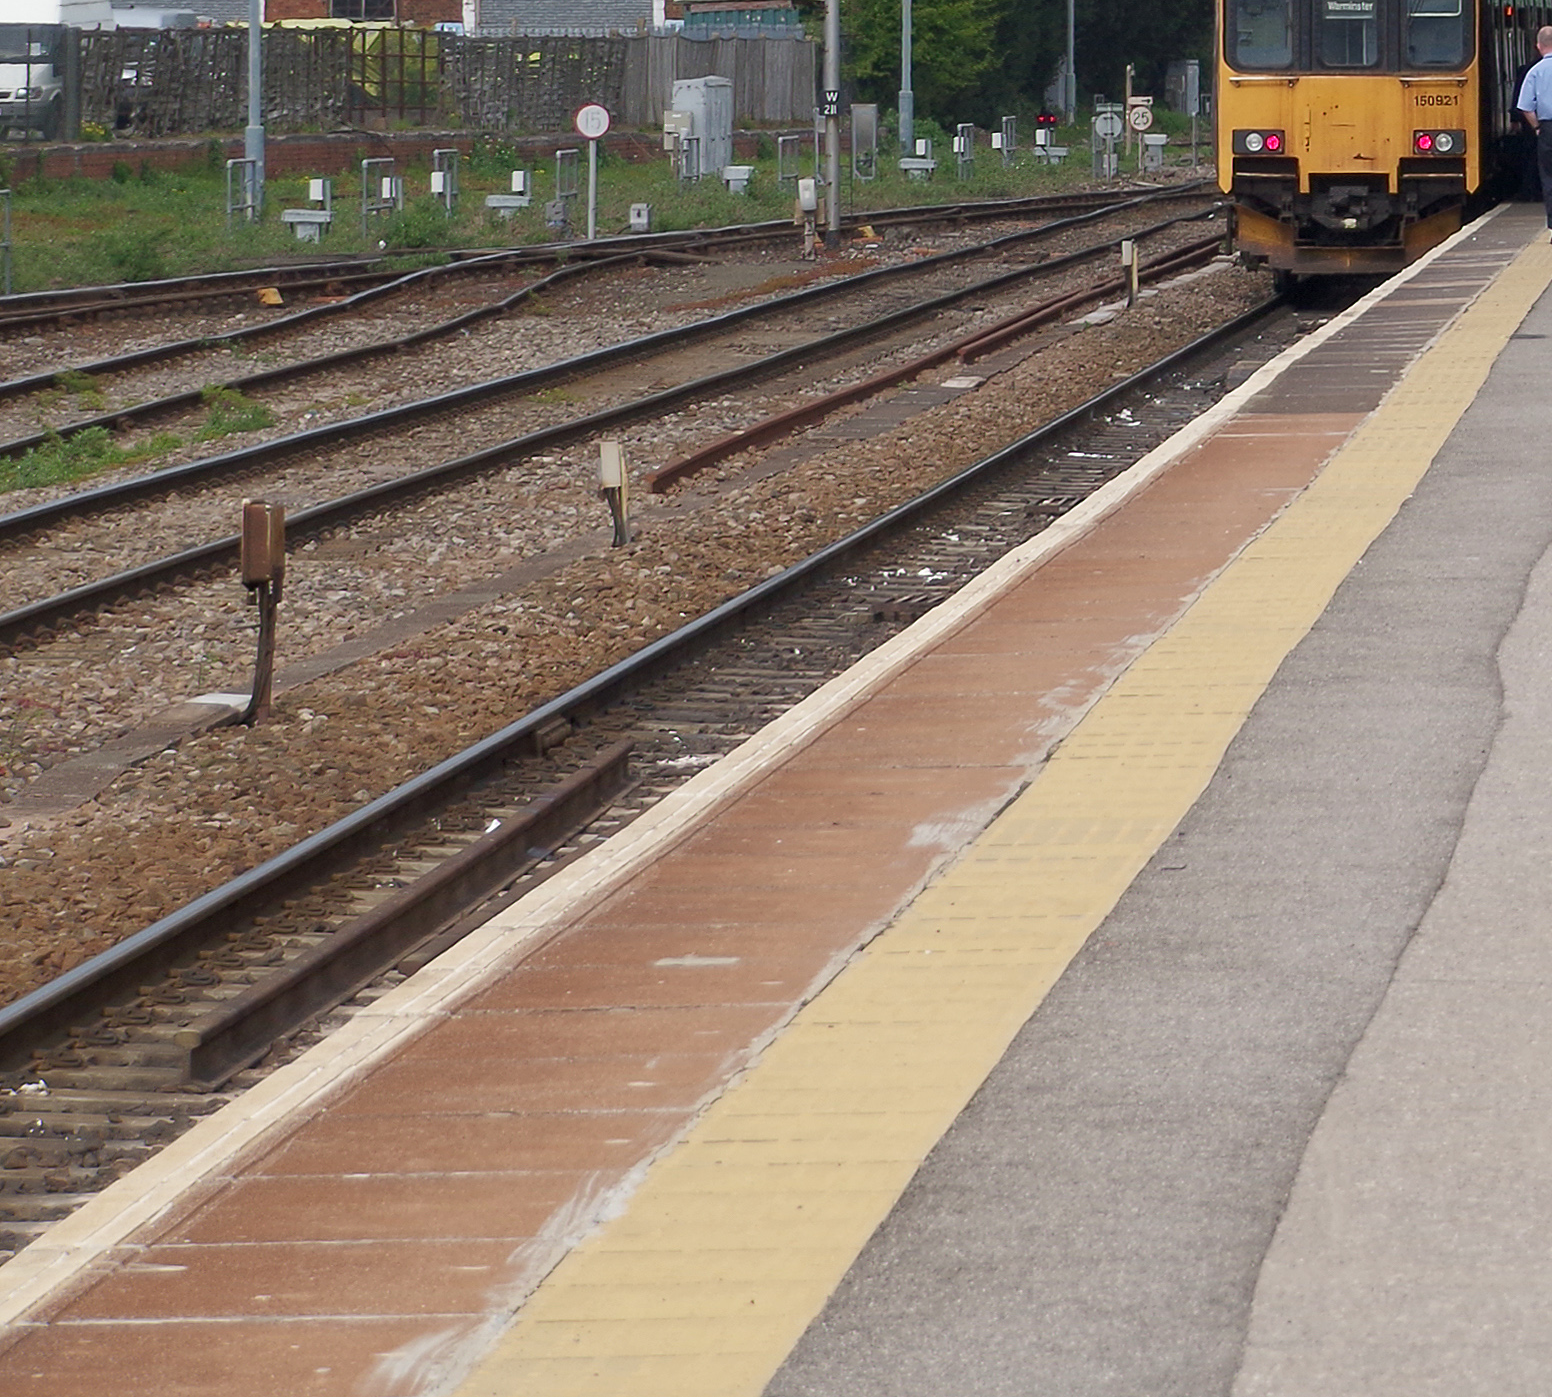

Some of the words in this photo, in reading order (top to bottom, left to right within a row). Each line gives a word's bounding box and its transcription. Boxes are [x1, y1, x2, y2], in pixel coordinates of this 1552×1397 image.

[1327, 1, 1374, 11] Warminster
[825, 92, 838, 102] W
[1414, 95, 1459, 107] 150921
[823, 104, 838, 115] 211
[585, 111, 601, 130] 15
[1133, 111, 1150, 126] 25
